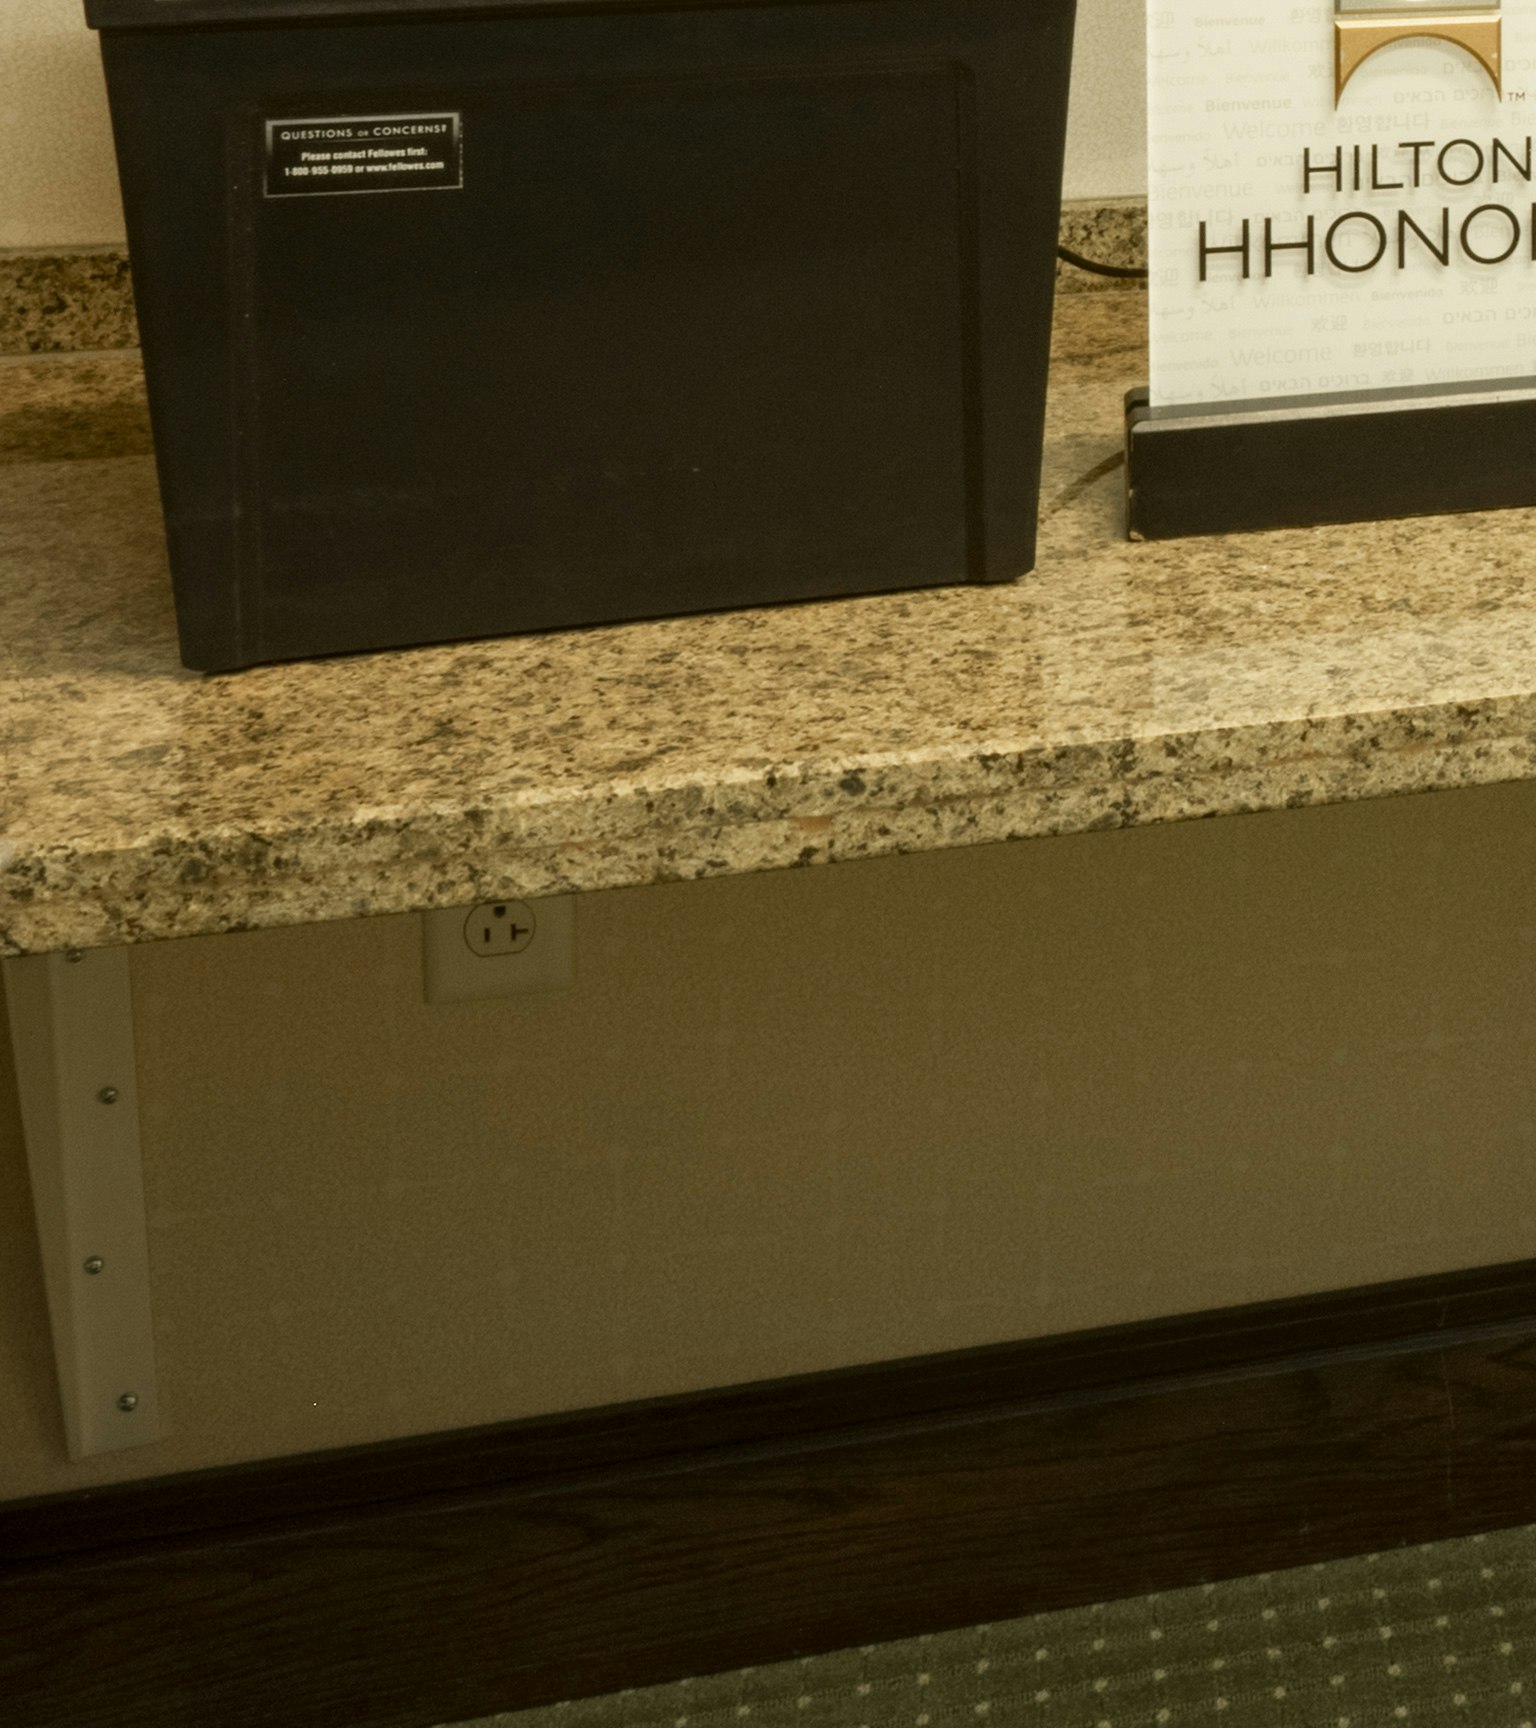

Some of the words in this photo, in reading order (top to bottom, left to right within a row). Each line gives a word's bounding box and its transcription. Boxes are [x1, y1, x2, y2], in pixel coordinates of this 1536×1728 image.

[281, 127, 353, 141] QUESTIONS
[373, 124, 449, 136] CONCERNS?
[1222, 119, 1326, 143] Welcome
[301, 151, 331, 162] Please
[333, 150, 366, 160] contact
[368, 148, 406, 159] Fellowes
[1303, 135, 1532, 194] HILTON
[355, 165, 364, 174] or
[366, 161, 445, 173] www.fellowes.com
[1229, 344, 1333, 367] Welcome
